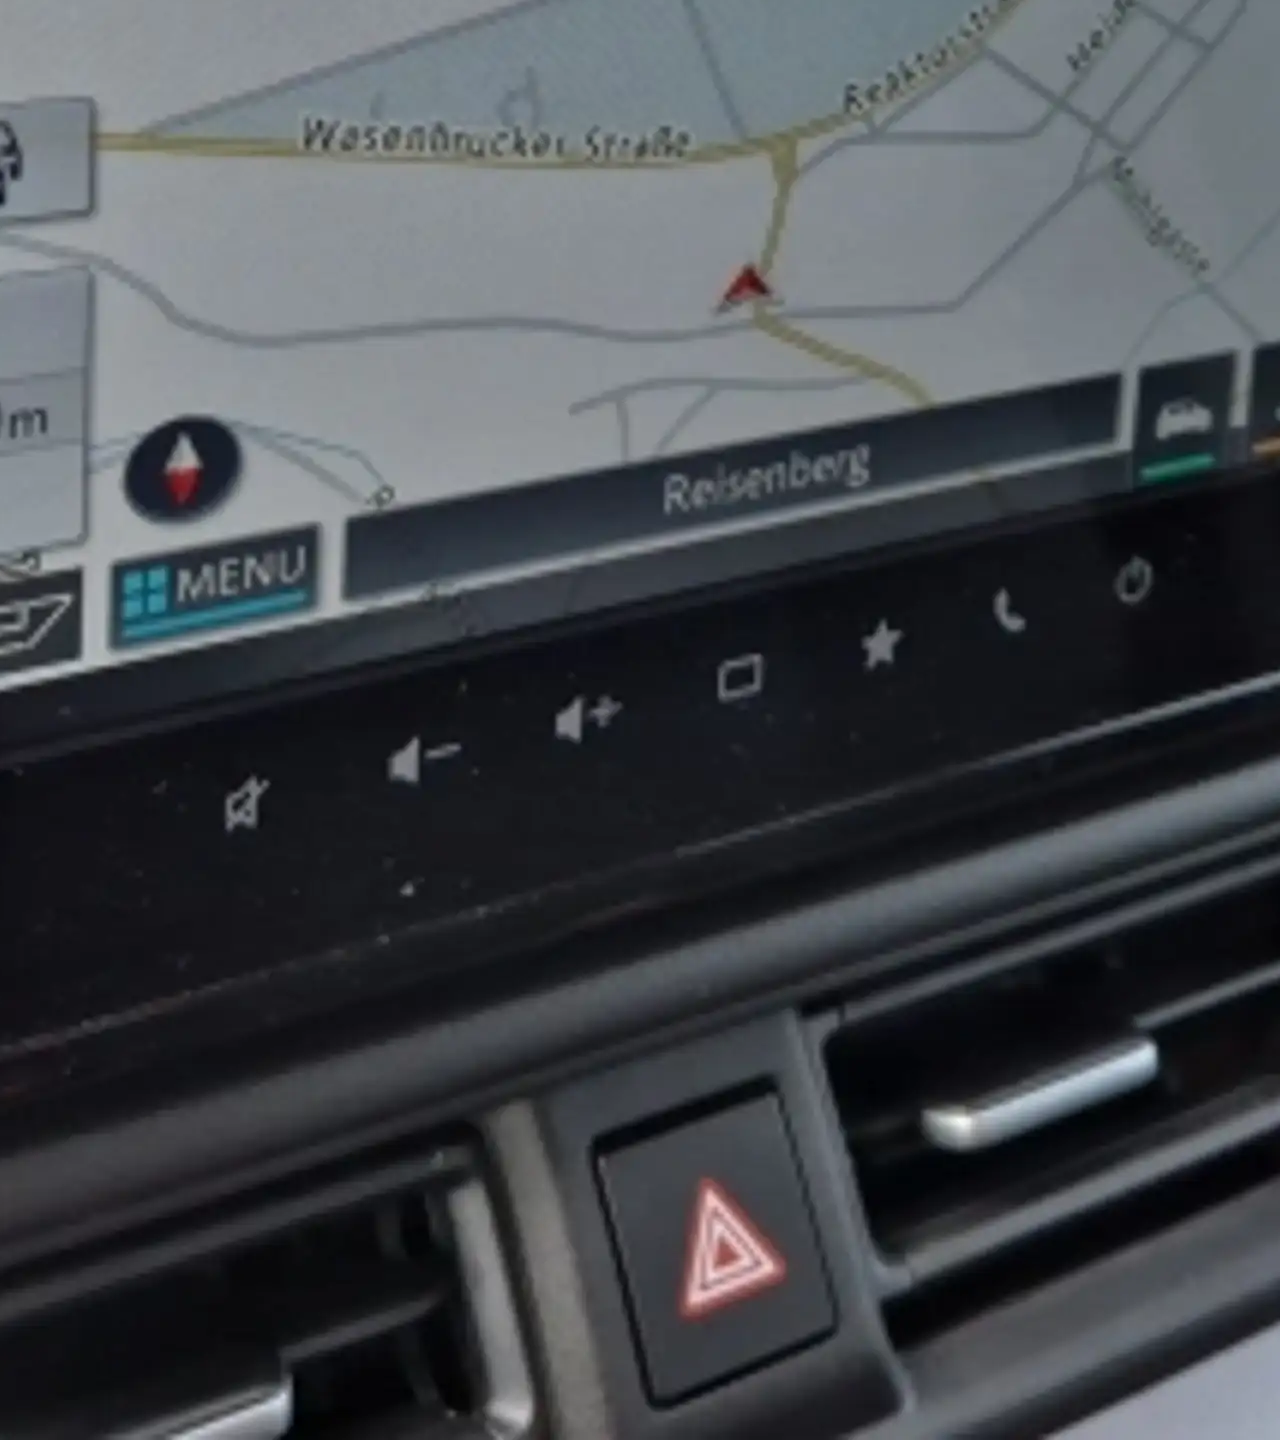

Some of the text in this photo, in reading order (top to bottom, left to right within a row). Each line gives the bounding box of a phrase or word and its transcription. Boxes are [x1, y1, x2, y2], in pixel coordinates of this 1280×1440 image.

[584, 124, 690, 162] Straße
[663, 444, 870, 514] Reisenberg
[176, 545, 306, 603] MENU
